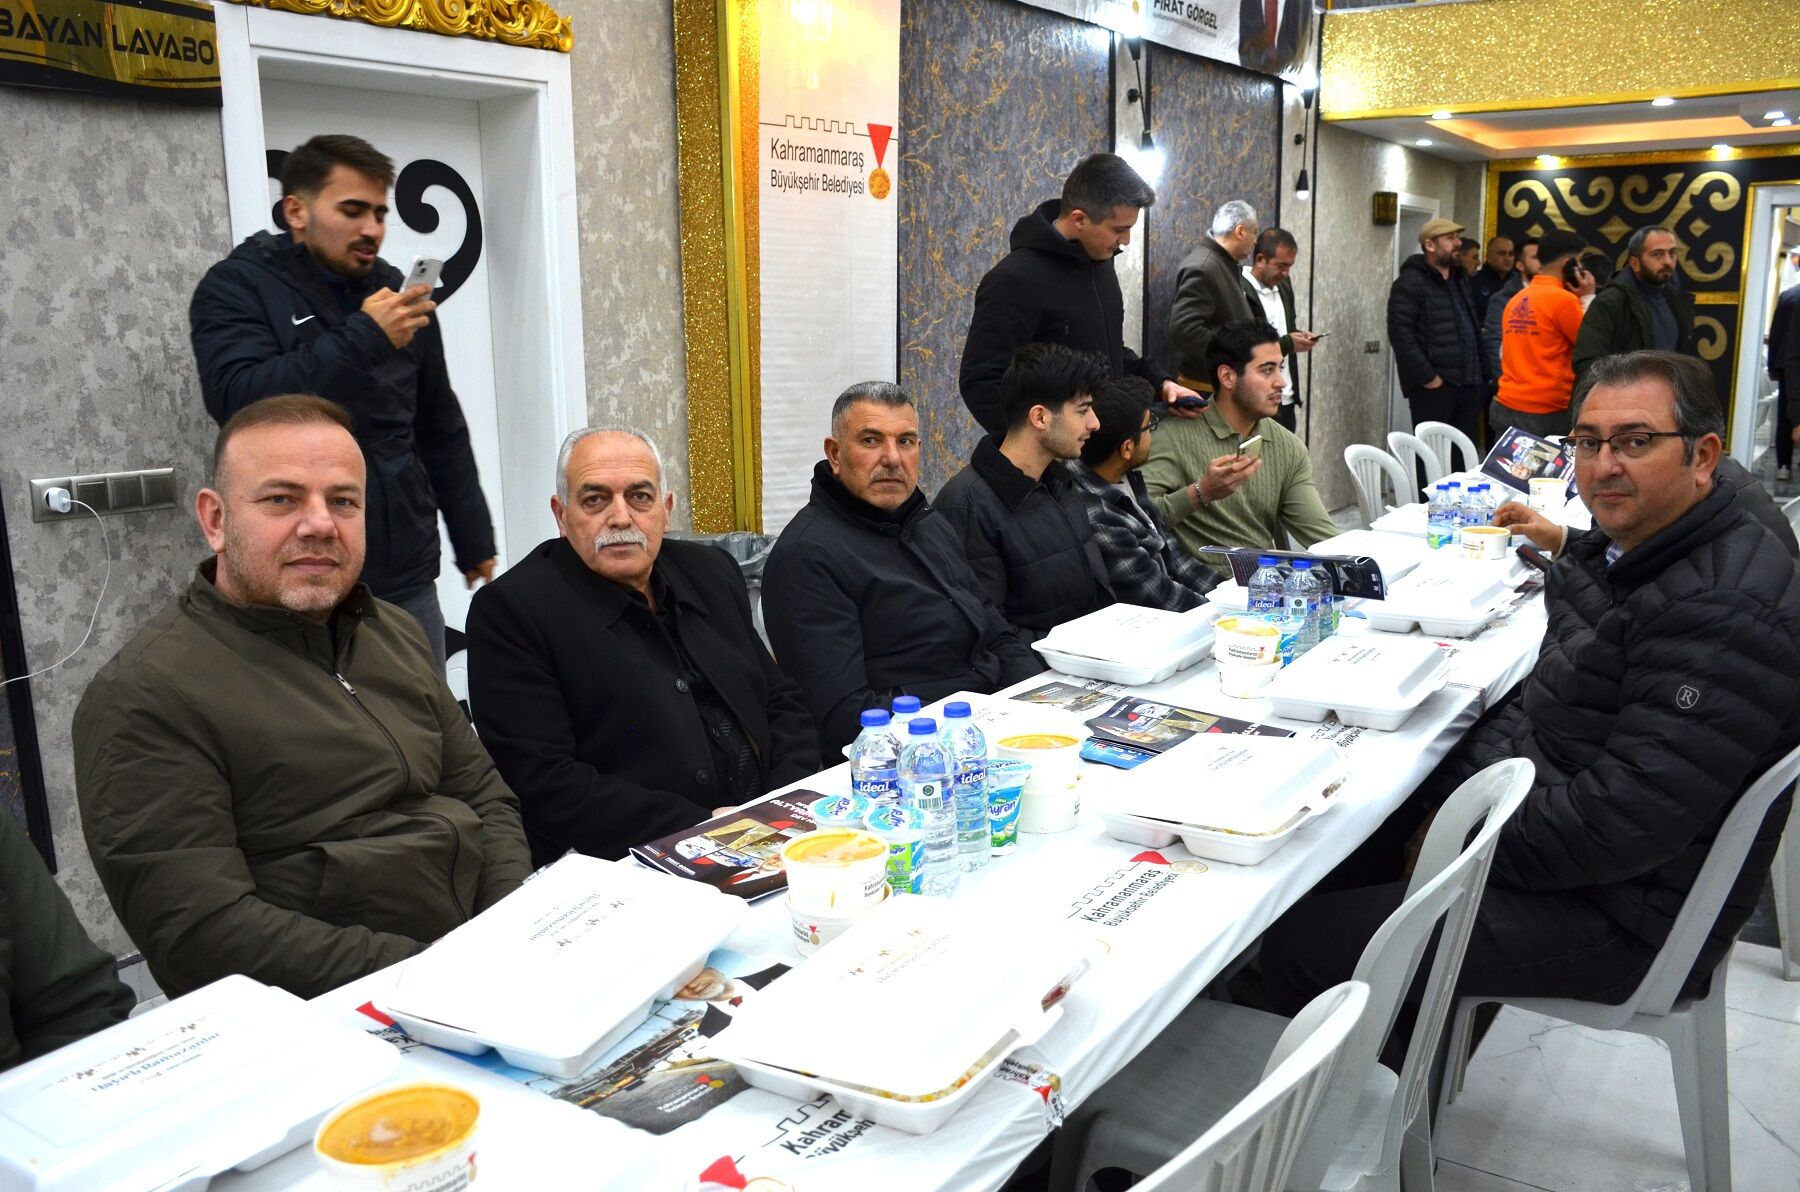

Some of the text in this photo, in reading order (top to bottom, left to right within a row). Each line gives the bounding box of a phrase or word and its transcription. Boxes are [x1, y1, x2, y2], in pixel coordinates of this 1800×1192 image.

[1154, 0, 1184, 16] FIRAT
[1187, 2, 1218, 30] GÖRGEL
[0, 8, 215, 65] BAYAN LAVABO
[771, 137, 865, 173] Kahramanmaraş
[770, 169, 865, 198] Büyükşehir Belediyesi
[1680, 689, 1692, 706] R
[859, 780, 890, 793] ideal
[961, 768, 987, 785] ideal
[1080, 868, 1163, 923] Kahramanmaraş
